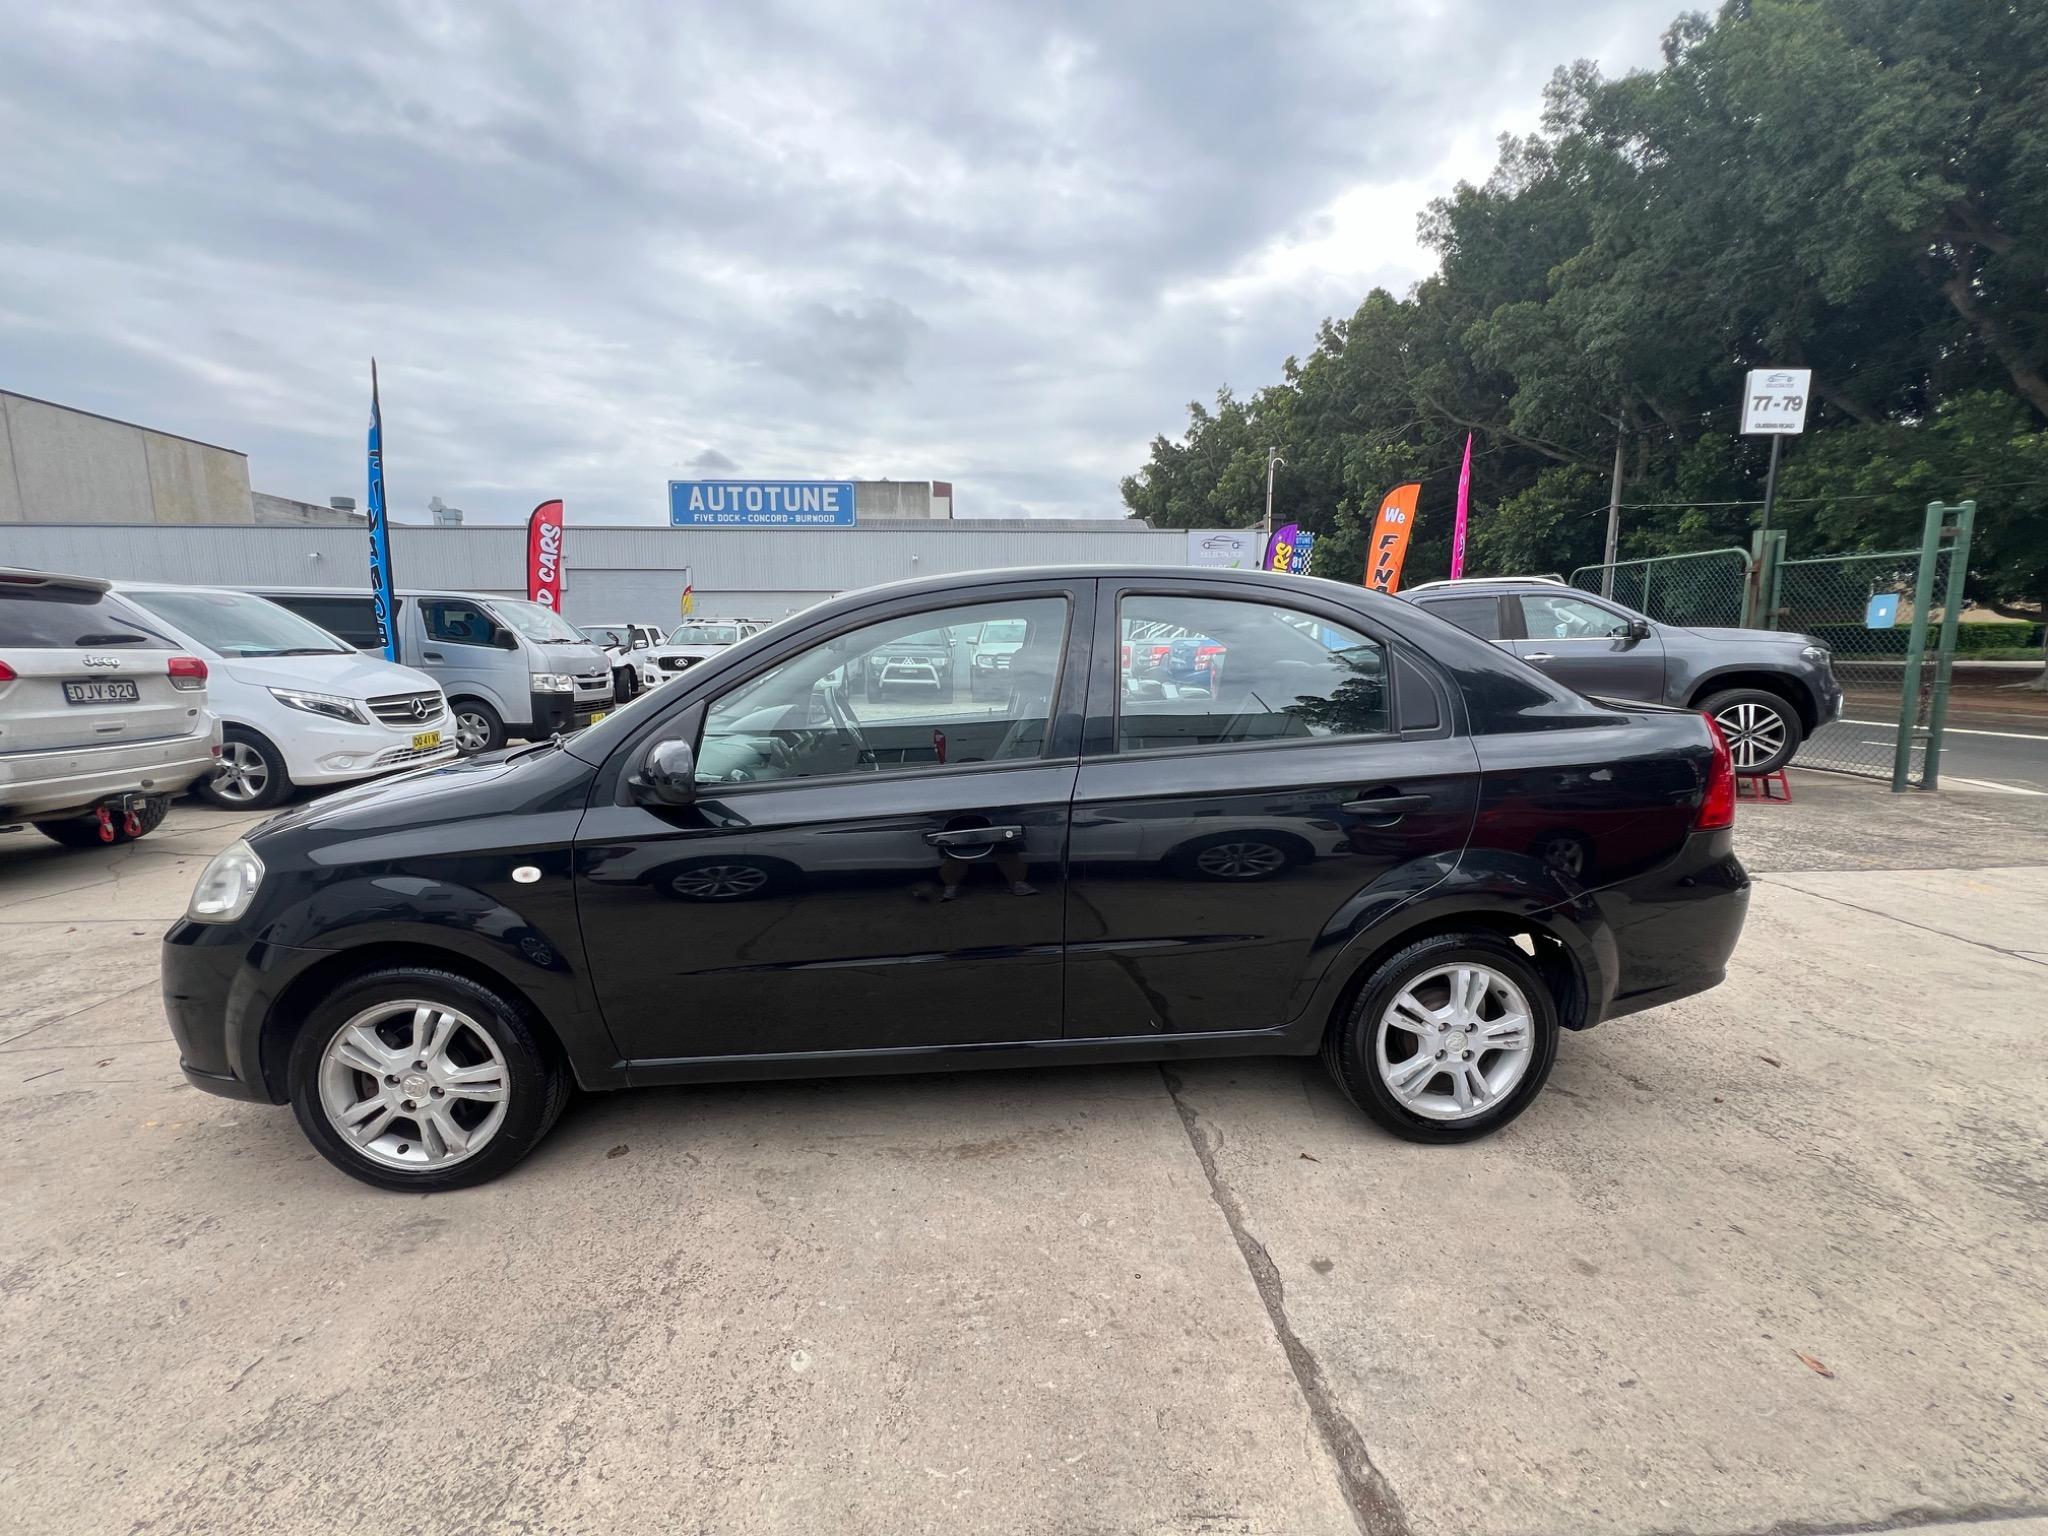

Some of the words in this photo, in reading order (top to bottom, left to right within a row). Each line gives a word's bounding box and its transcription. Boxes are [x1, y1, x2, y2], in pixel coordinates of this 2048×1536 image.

[689, 486, 839, 512] AUTOTUNE
[694, 514, 714, 522] FIVE
[1385, 507, 1405, 524] We
[538, 523, 560, 583] CARS
[83, 655, 120, 668] Jeep
